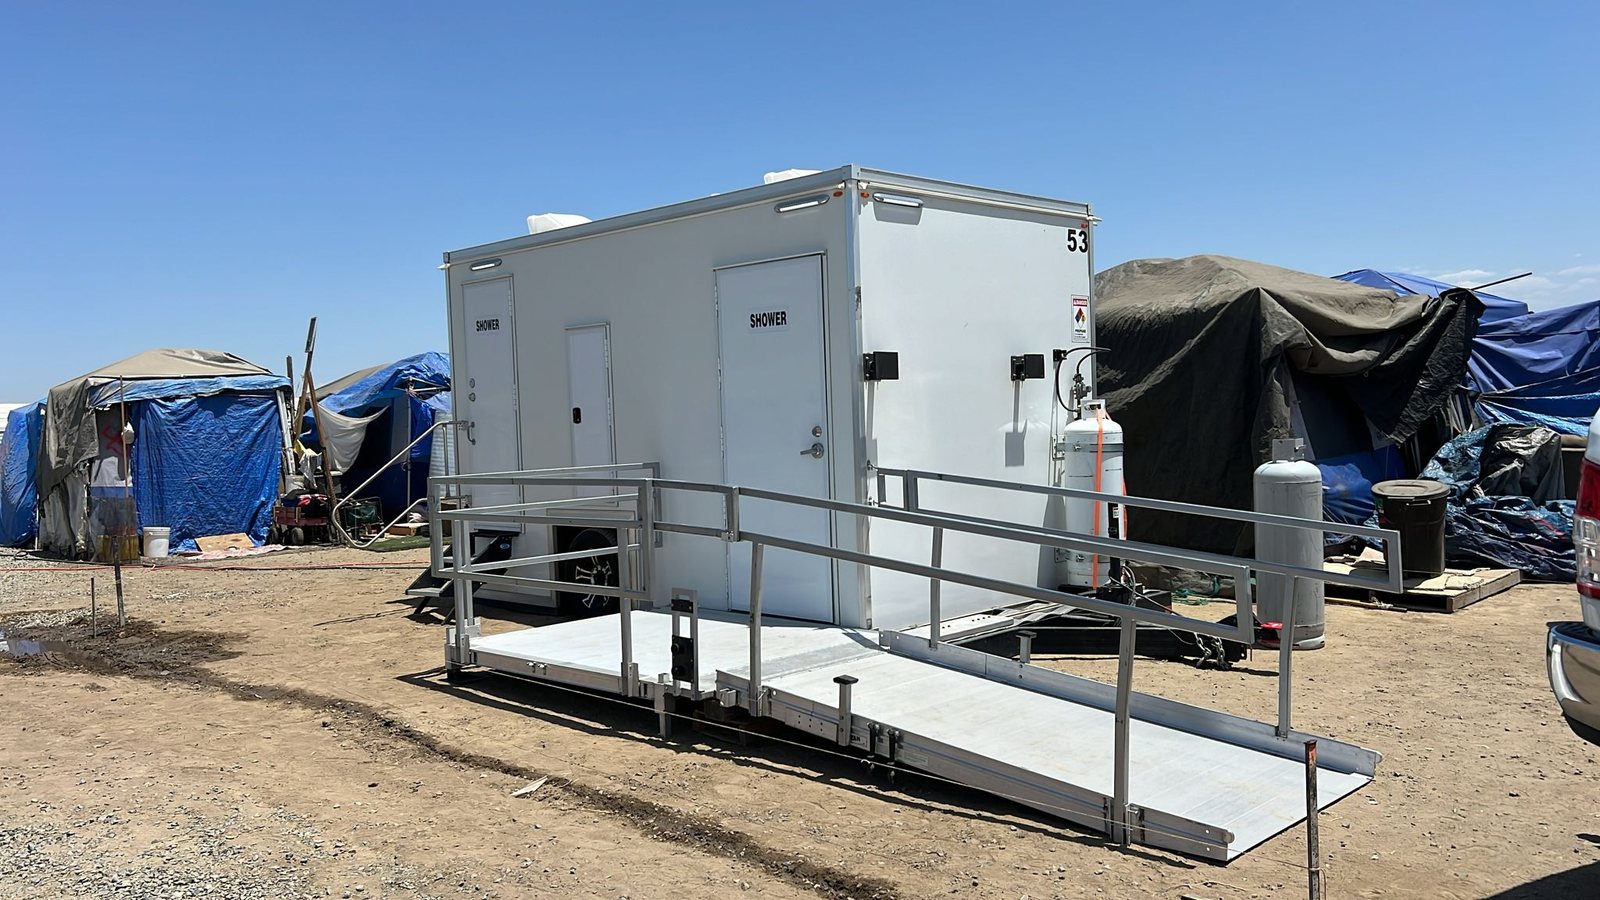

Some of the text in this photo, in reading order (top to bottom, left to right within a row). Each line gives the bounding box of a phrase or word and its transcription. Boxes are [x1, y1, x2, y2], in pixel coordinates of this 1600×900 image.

[1067, 229, 1088, 253] 53
[476, 319, 499, 331] SHOWER
[750, 311, 787, 328] SHOWER
